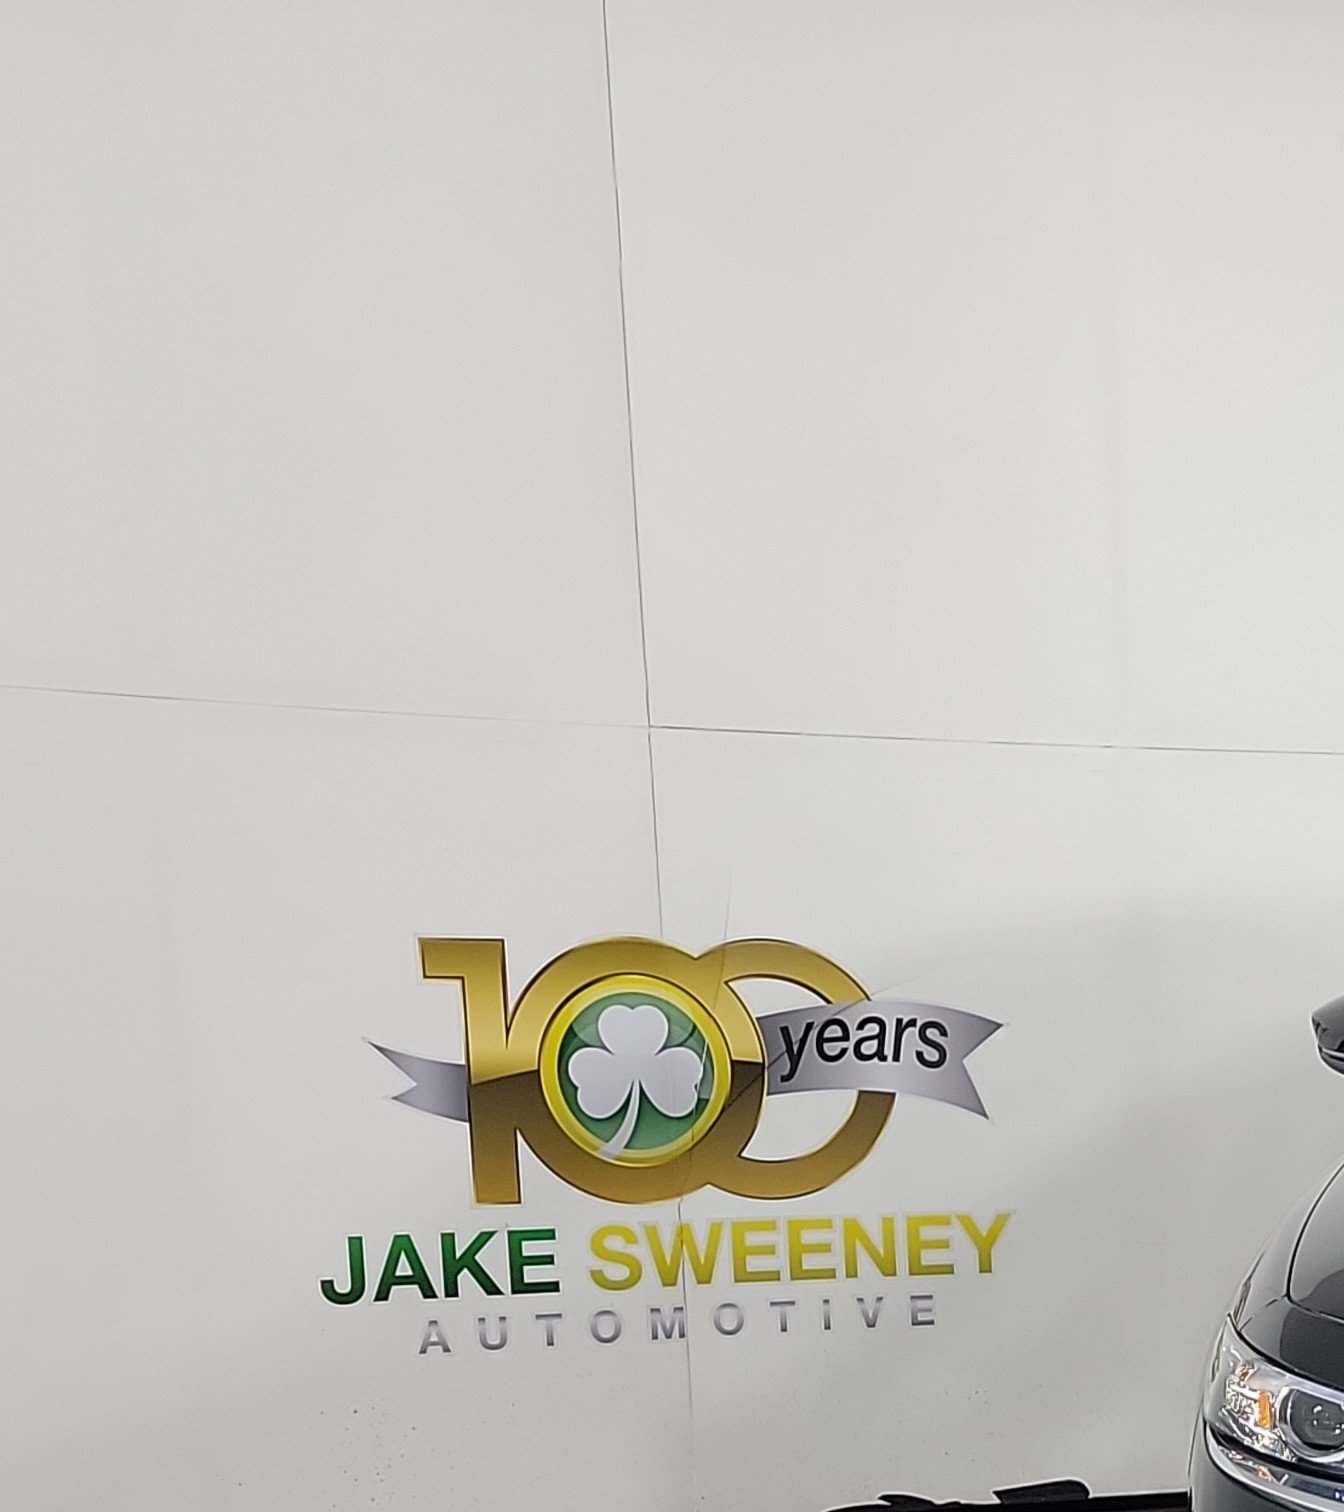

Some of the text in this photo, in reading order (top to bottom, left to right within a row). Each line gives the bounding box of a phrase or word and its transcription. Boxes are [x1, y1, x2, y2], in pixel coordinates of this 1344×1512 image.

[418, 936, 950, 1206] 100 years
[320, 1212, 1012, 1305] JAKE SWEENEY
[418, 1294, 935, 1355] AUTOMOTIVE
